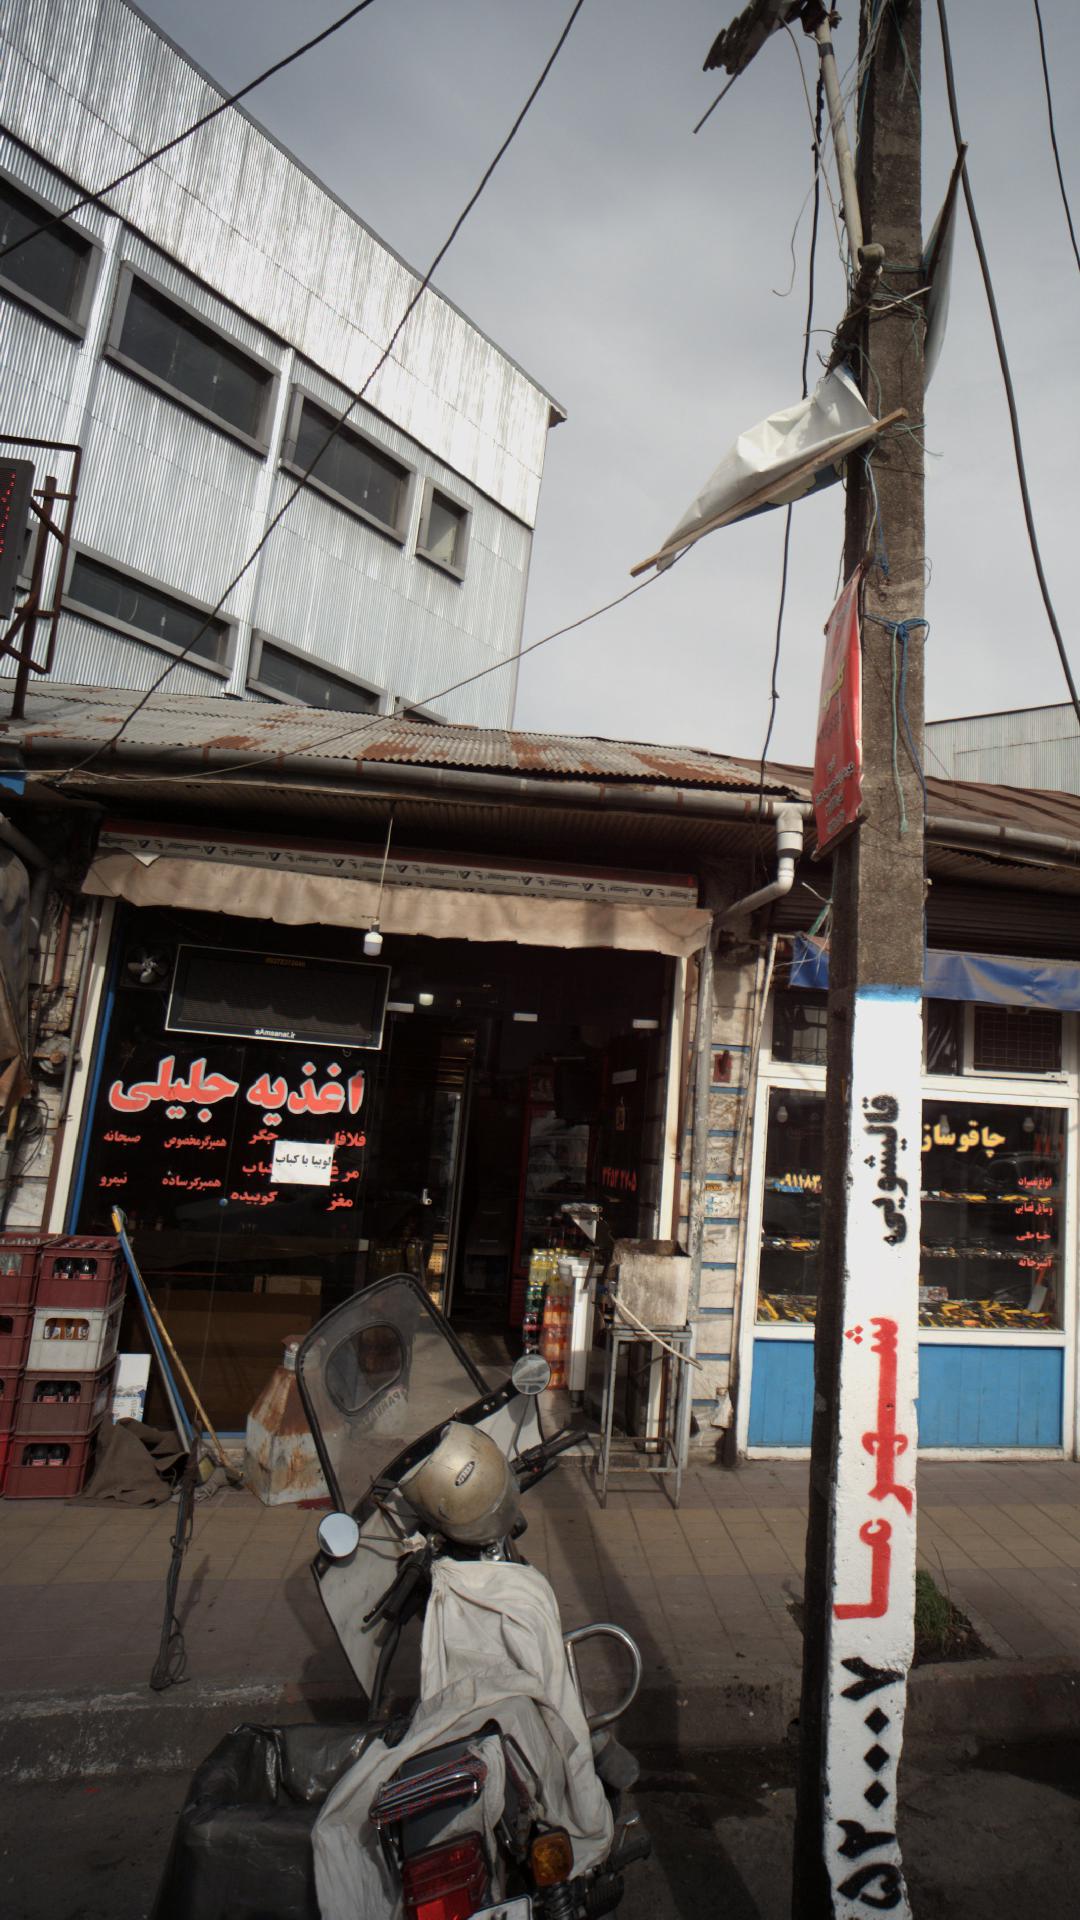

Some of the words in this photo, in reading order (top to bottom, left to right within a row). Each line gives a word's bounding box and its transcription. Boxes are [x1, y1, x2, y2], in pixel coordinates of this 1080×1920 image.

[109, 1055, 240, 1123] جلیلی
[246, 1061, 365, 1126] اغذیه
[103, 1129, 142, 1145] صبحانه
[242, 1161, 273, 1176] باب
[275, 1154, 301, 1167] کباب
[301, 1156, 310, 1168] با
[311, 1156, 332, 1170] لوبیا
[862, 1094, 909, 1247] قالیشویی
[99, 1172, 128, 1187] نیمرو
[230, 1191, 279, 1205] کوبیده
[326, 1192, 354, 1211] مغز
[845, 1317, 914, 1515] شهر
[834, 1519, 892, 1620] ما
